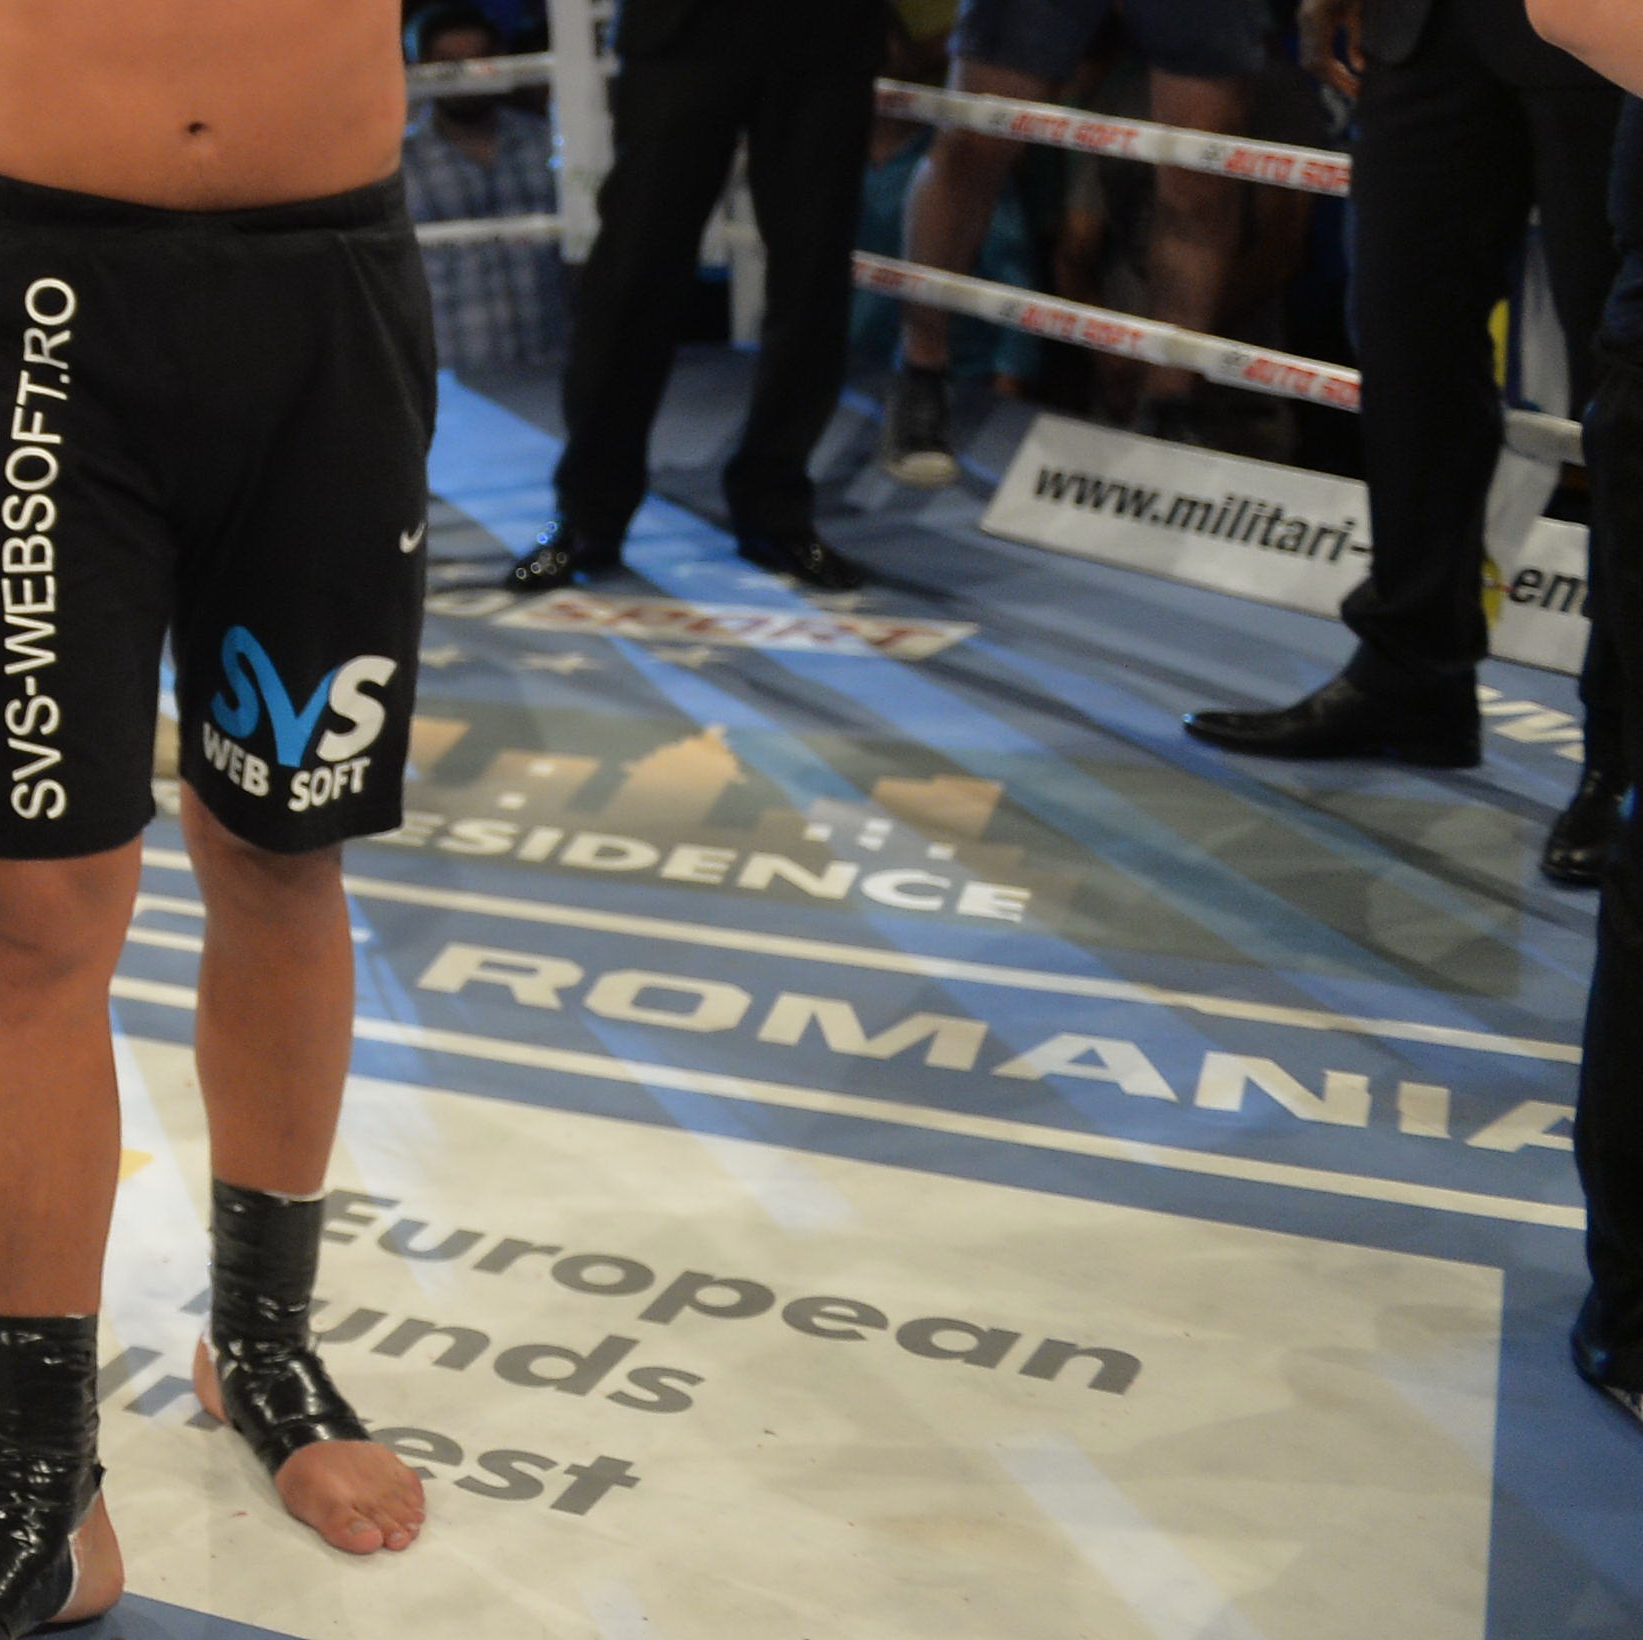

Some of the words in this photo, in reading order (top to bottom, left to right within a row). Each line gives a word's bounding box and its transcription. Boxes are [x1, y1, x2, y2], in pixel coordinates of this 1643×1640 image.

[1, 277, 78, 820] SVS-WEBSOFT.RO
[211, 625, 397, 768] SVS
[203, 722, 270, 799] WEB
[288, 756, 371, 813] SOFT
[377, 811, 1032, 923] ESIDENCE
[309, 1296, 706, 1415] unds
[317, 1187, 1144, 1397] European
